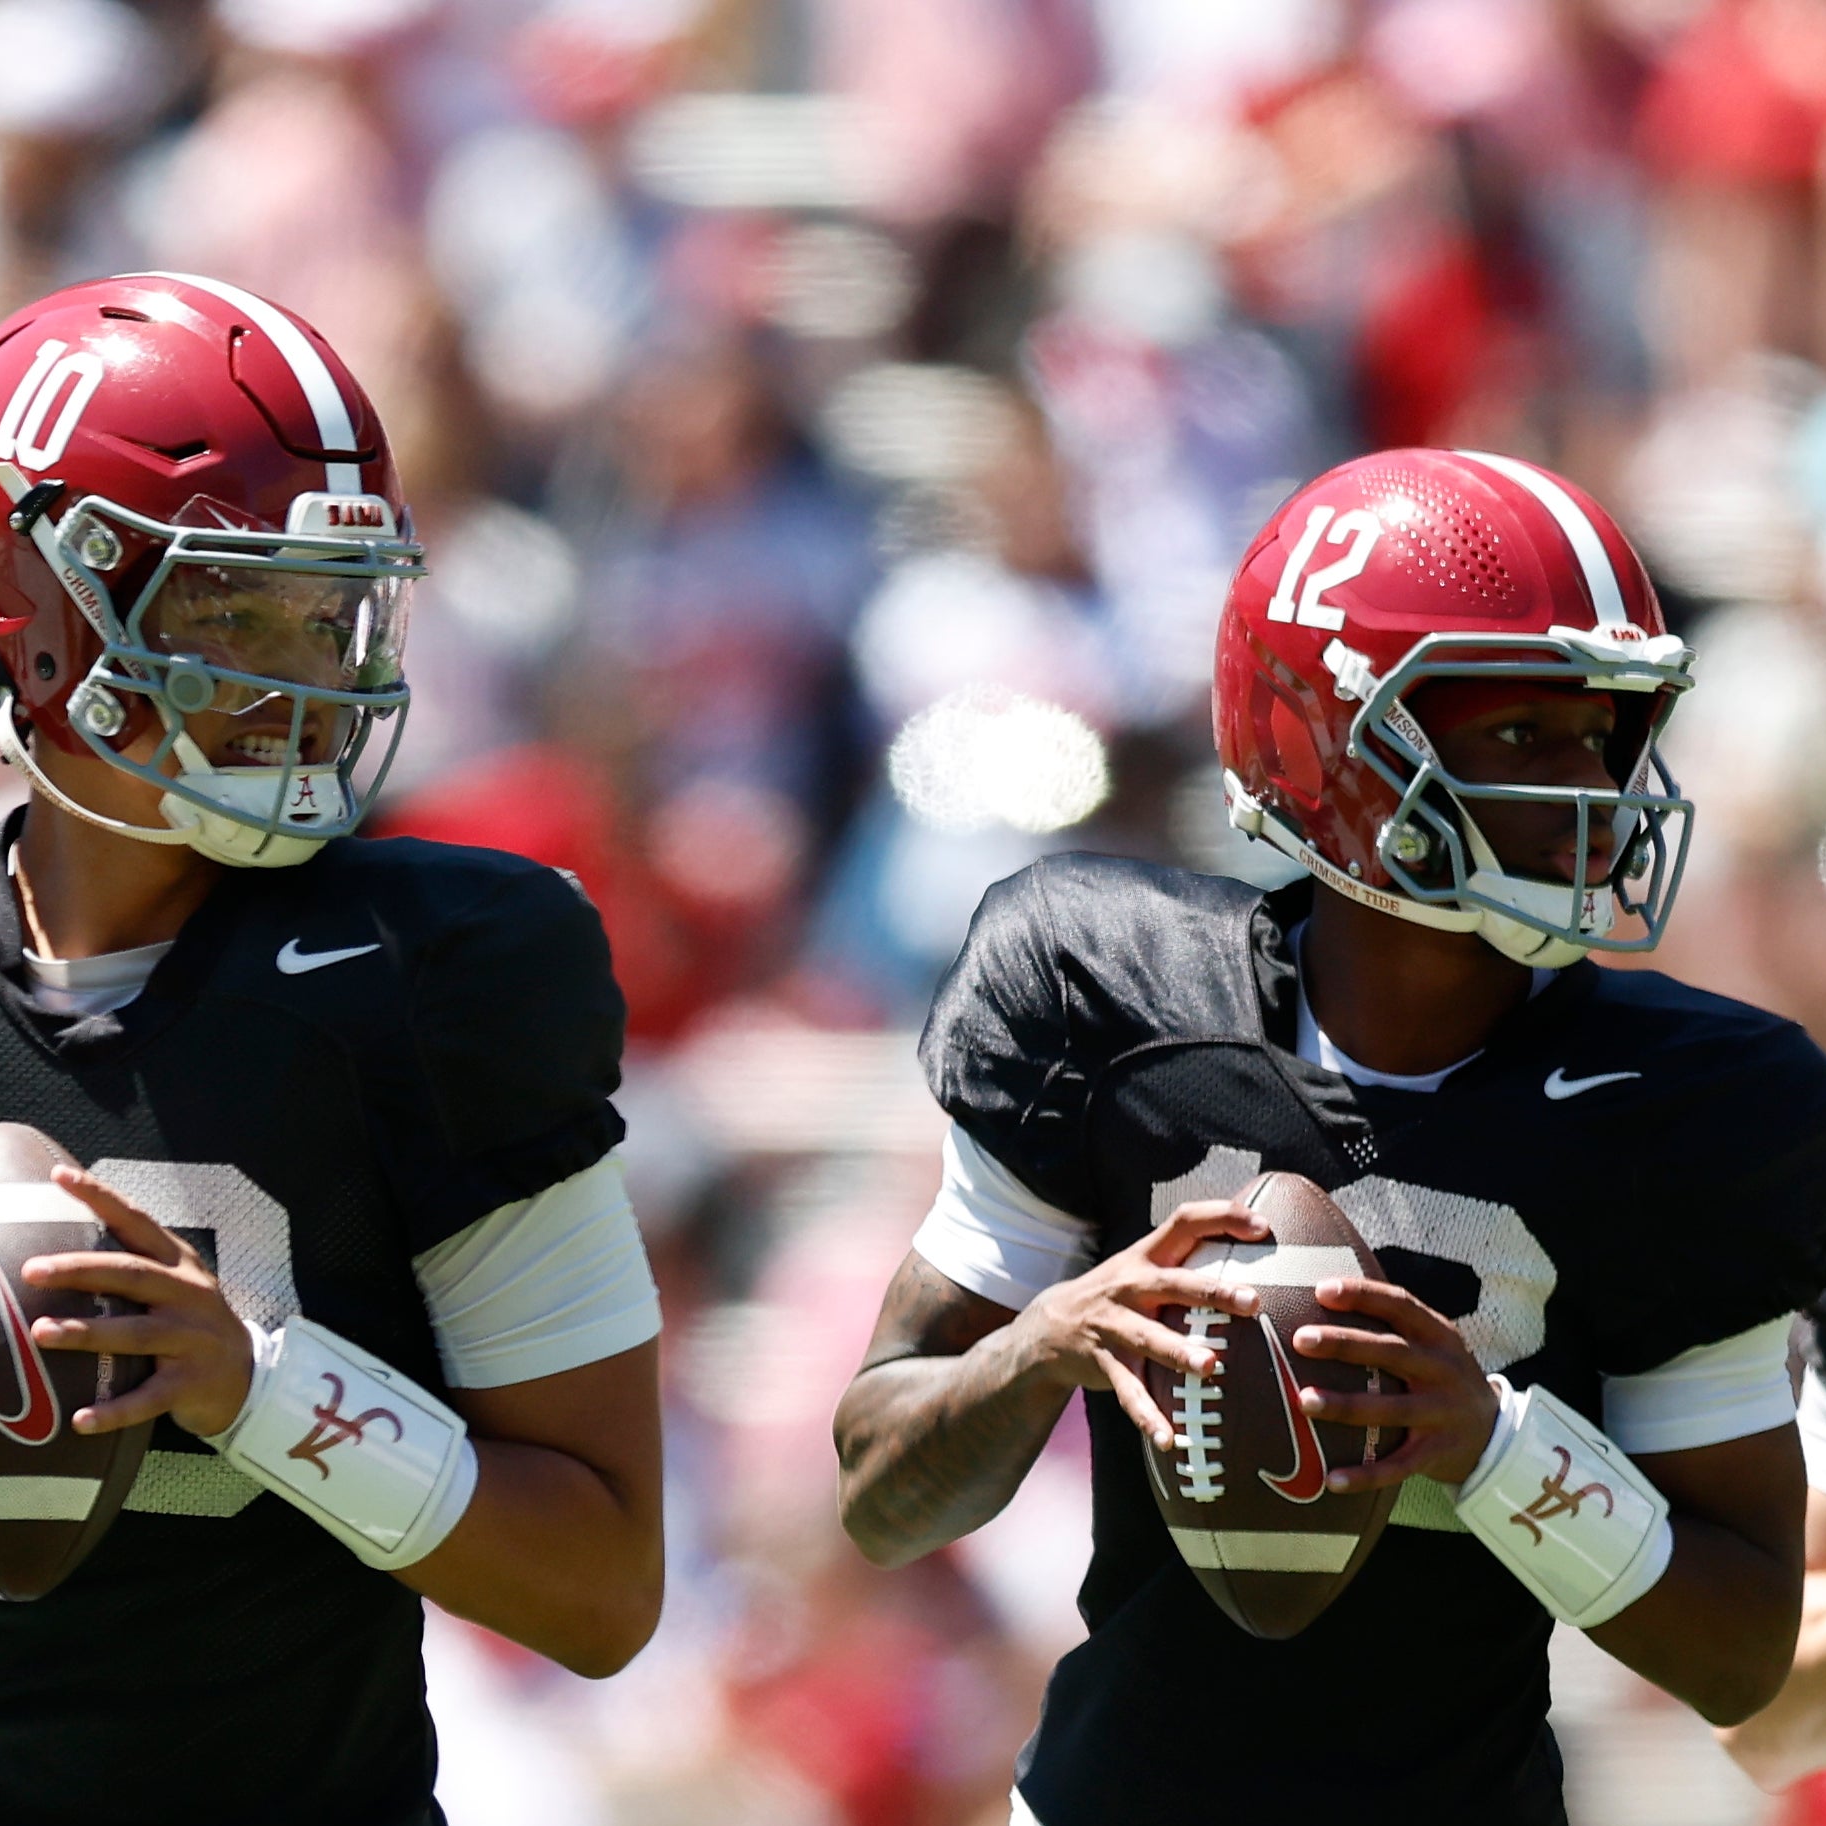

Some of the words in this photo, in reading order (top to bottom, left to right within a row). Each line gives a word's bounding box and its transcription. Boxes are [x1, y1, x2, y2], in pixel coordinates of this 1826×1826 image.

[327, 503, 384, 528] BAMA
[1267, 505, 1381, 631] 12
[290, 774, 317, 808] A
[1298, 848, 1358, 897] CRIMSON
[1363, 890, 1400, 912] TIDE
[288, 1371, 404, 1481] A
[1510, 1445, 1614, 1547] A
